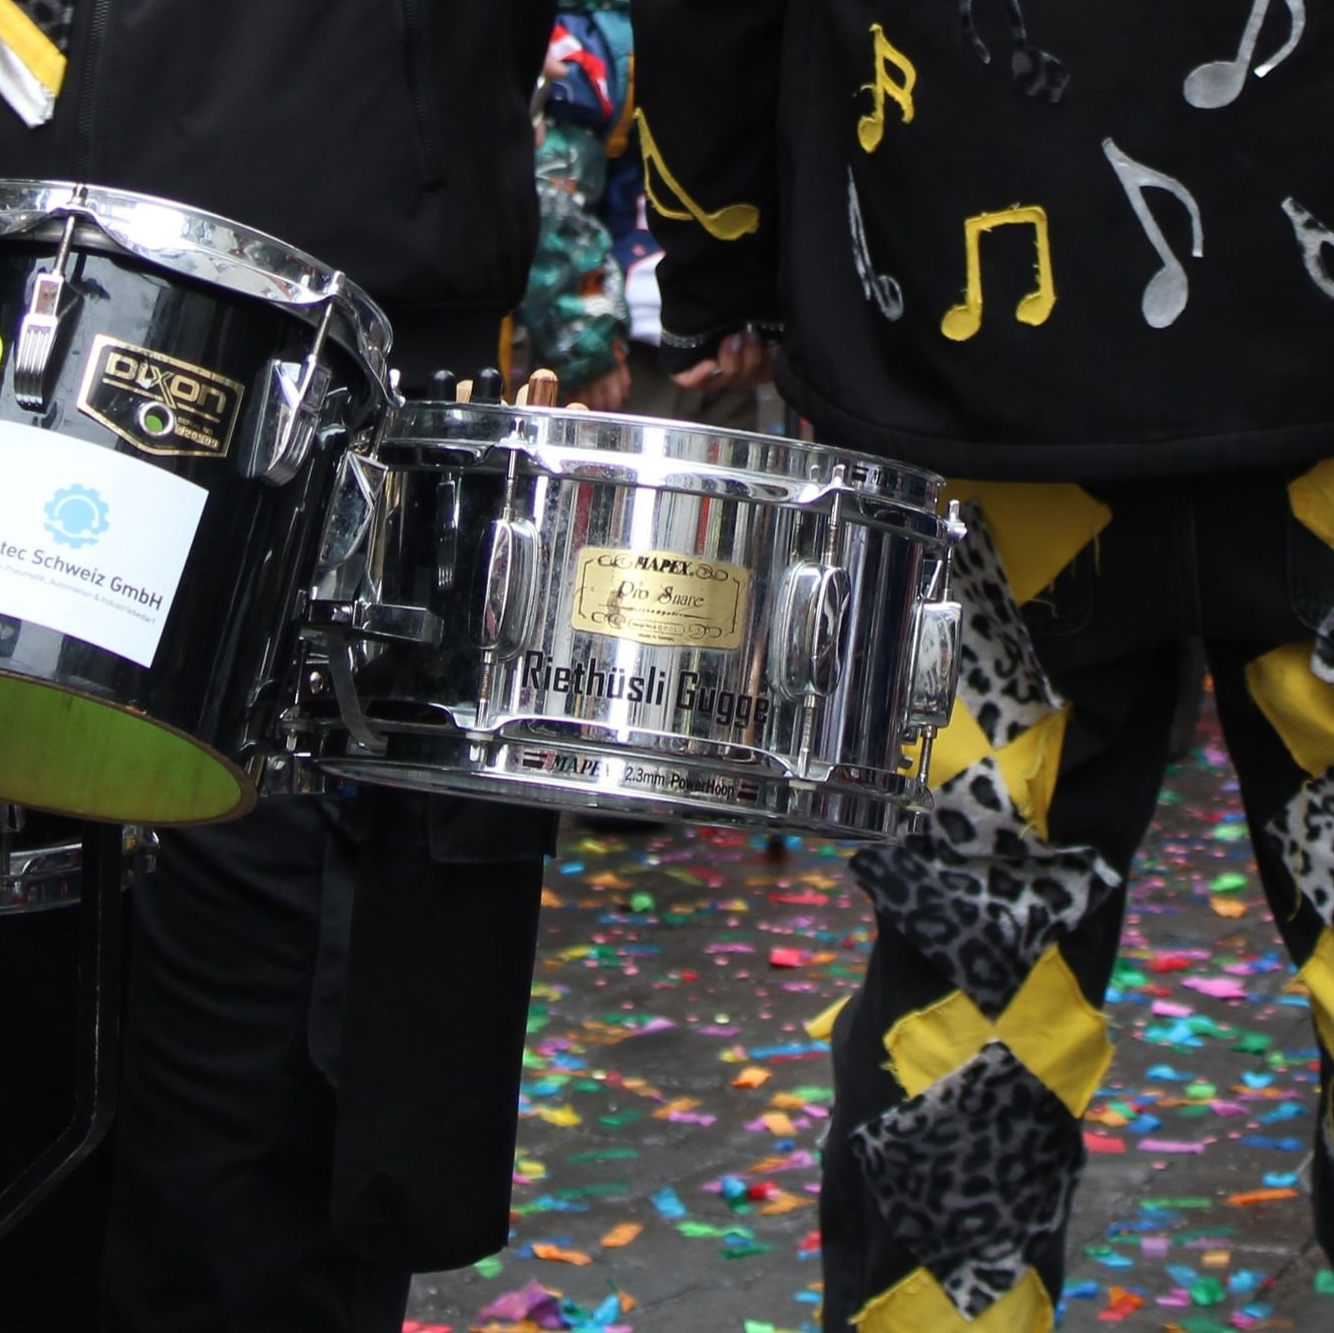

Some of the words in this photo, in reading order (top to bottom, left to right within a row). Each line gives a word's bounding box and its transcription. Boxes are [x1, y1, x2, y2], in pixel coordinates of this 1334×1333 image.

[31, 549, 106, 587] Schweiz
[110, 576, 163, 611] GmbH
[617, 580, 649, 599] Pro
[657, 585, 704, 608] Snare
[521, 649, 666, 706] Riethüsli
[676, 670, 769, 729] Gugge
[625, 767, 665, 787] 2.3mm
[670, 775, 736, 801] PowerHoop
